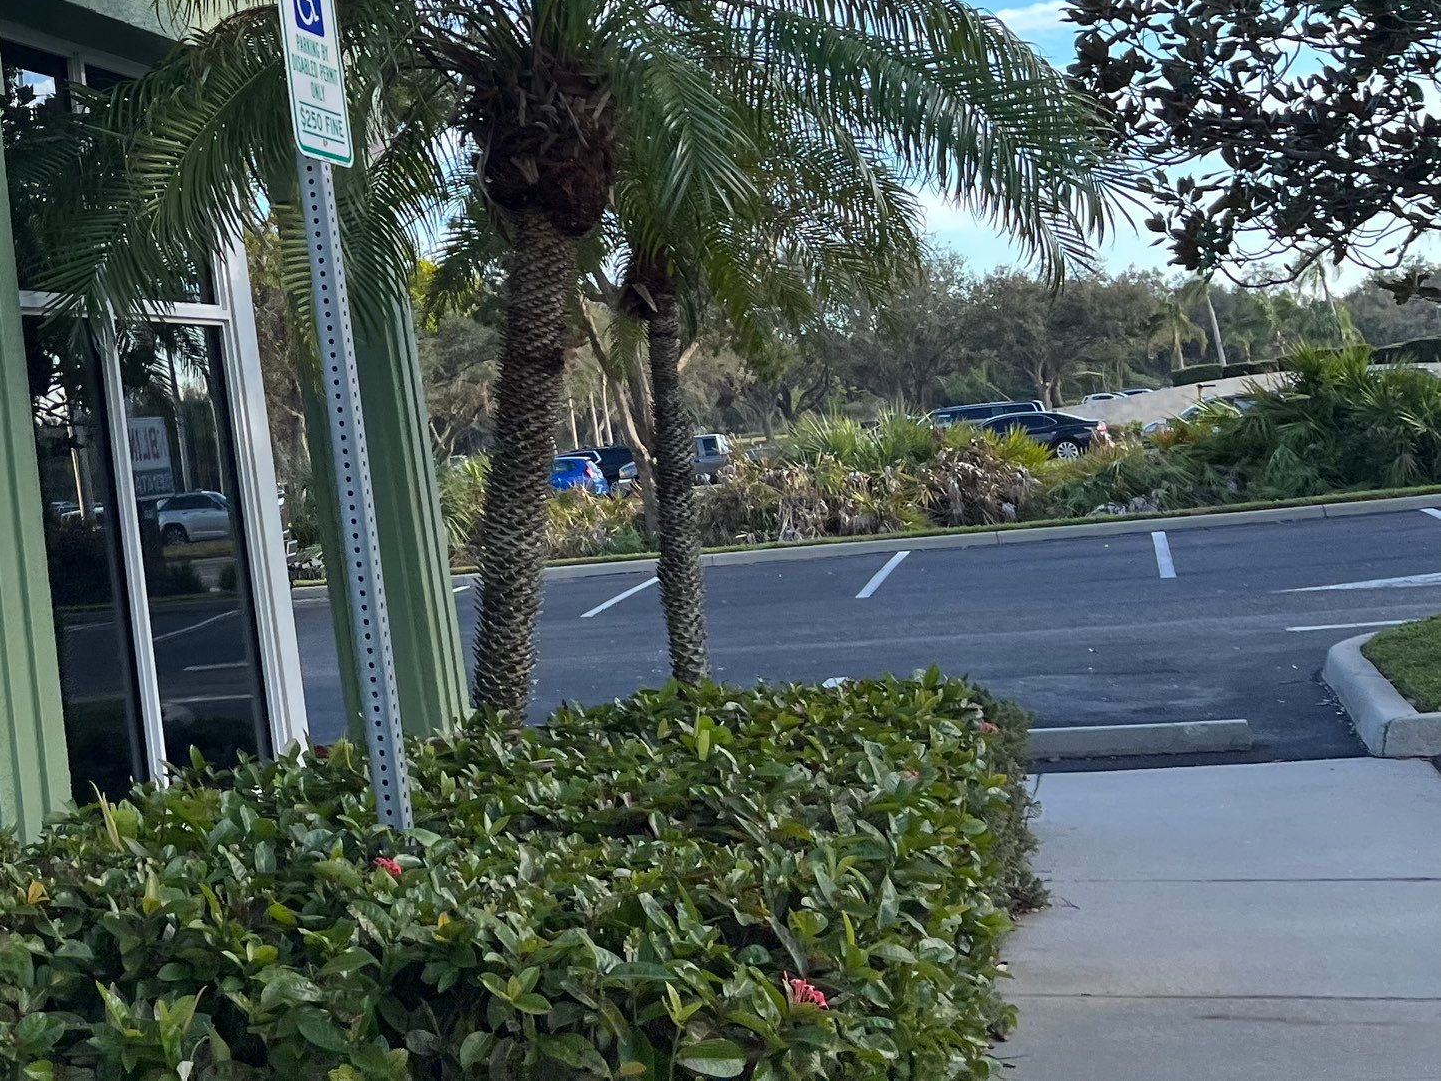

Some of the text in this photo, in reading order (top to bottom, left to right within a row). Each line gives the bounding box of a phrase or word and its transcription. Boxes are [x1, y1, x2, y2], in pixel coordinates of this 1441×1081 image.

[296, 33, 329, 62] PARKING BY
[291, 53, 338, 86] DISABLED PERMIT
[310, 81, 325, 102] ONLY
[300, 105, 344, 138] $250 FINE
